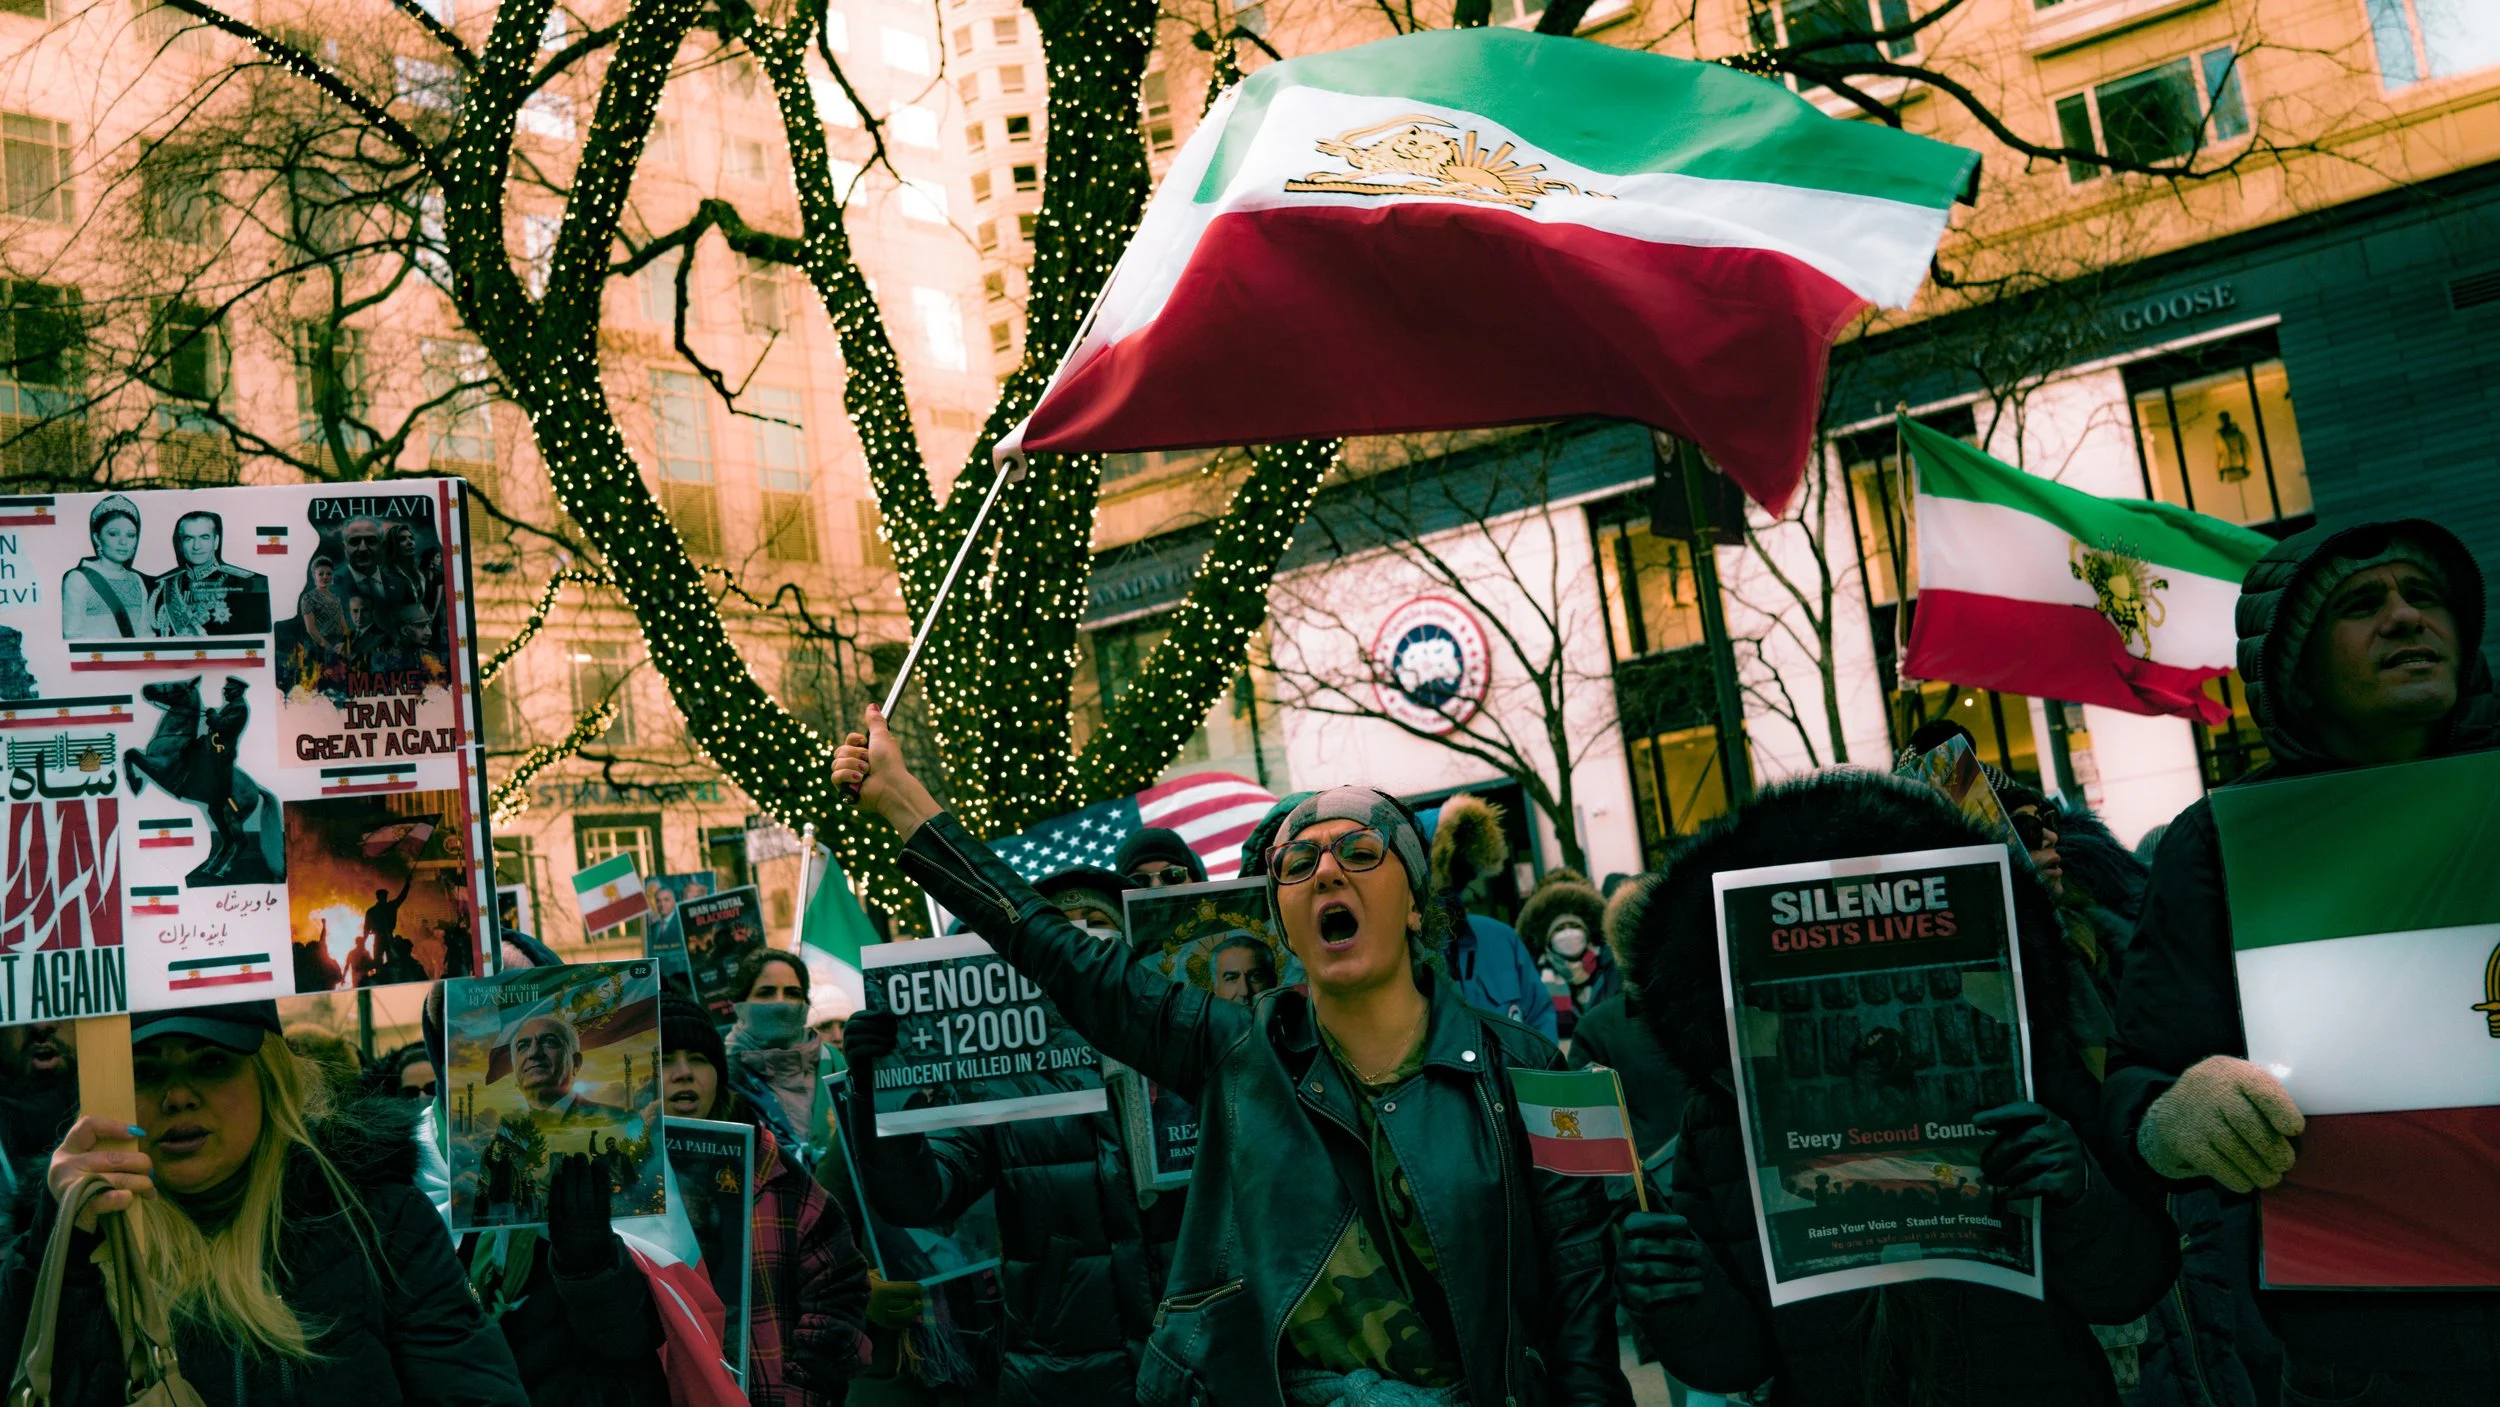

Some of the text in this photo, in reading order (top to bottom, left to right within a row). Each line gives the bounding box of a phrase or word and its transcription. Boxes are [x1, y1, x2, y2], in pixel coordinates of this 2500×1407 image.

[2121, 283, 2236, 332] GOOSE
[314, 495, 429, 520] PAHLAVI
[348, 669, 423, 699] MAKE
[343, 698, 417, 730] IRAN
[295, 733, 379, 761] GREAT
[688, 903, 709, 918] IRAN
[717, 896, 744, 910] TOTAL
[1771, 877, 1948, 924] SILENCE
[696, 907, 740, 926] BLACKOUT
[1772, 913, 1957, 952] COSTS LIVES
[31, 947, 128, 1020] AGAIN
[634, 967, 647, 976] 2/2
[888, 965, 1042, 1015] GENOCID
[912, 1005, 1047, 1056] +12000
[875, 1046, 1098, 1090] INNOCENT KILLED IN 2 DAYS.
[664, 1138, 741, 1158] ZA PAHLAVI
[1787, 1129, 1842, 1150] Every
[1847, 1123, 1919, 1146] Second
[1808, 1213, 2002, 1239] Raise Your Voice Stand for Freedom
